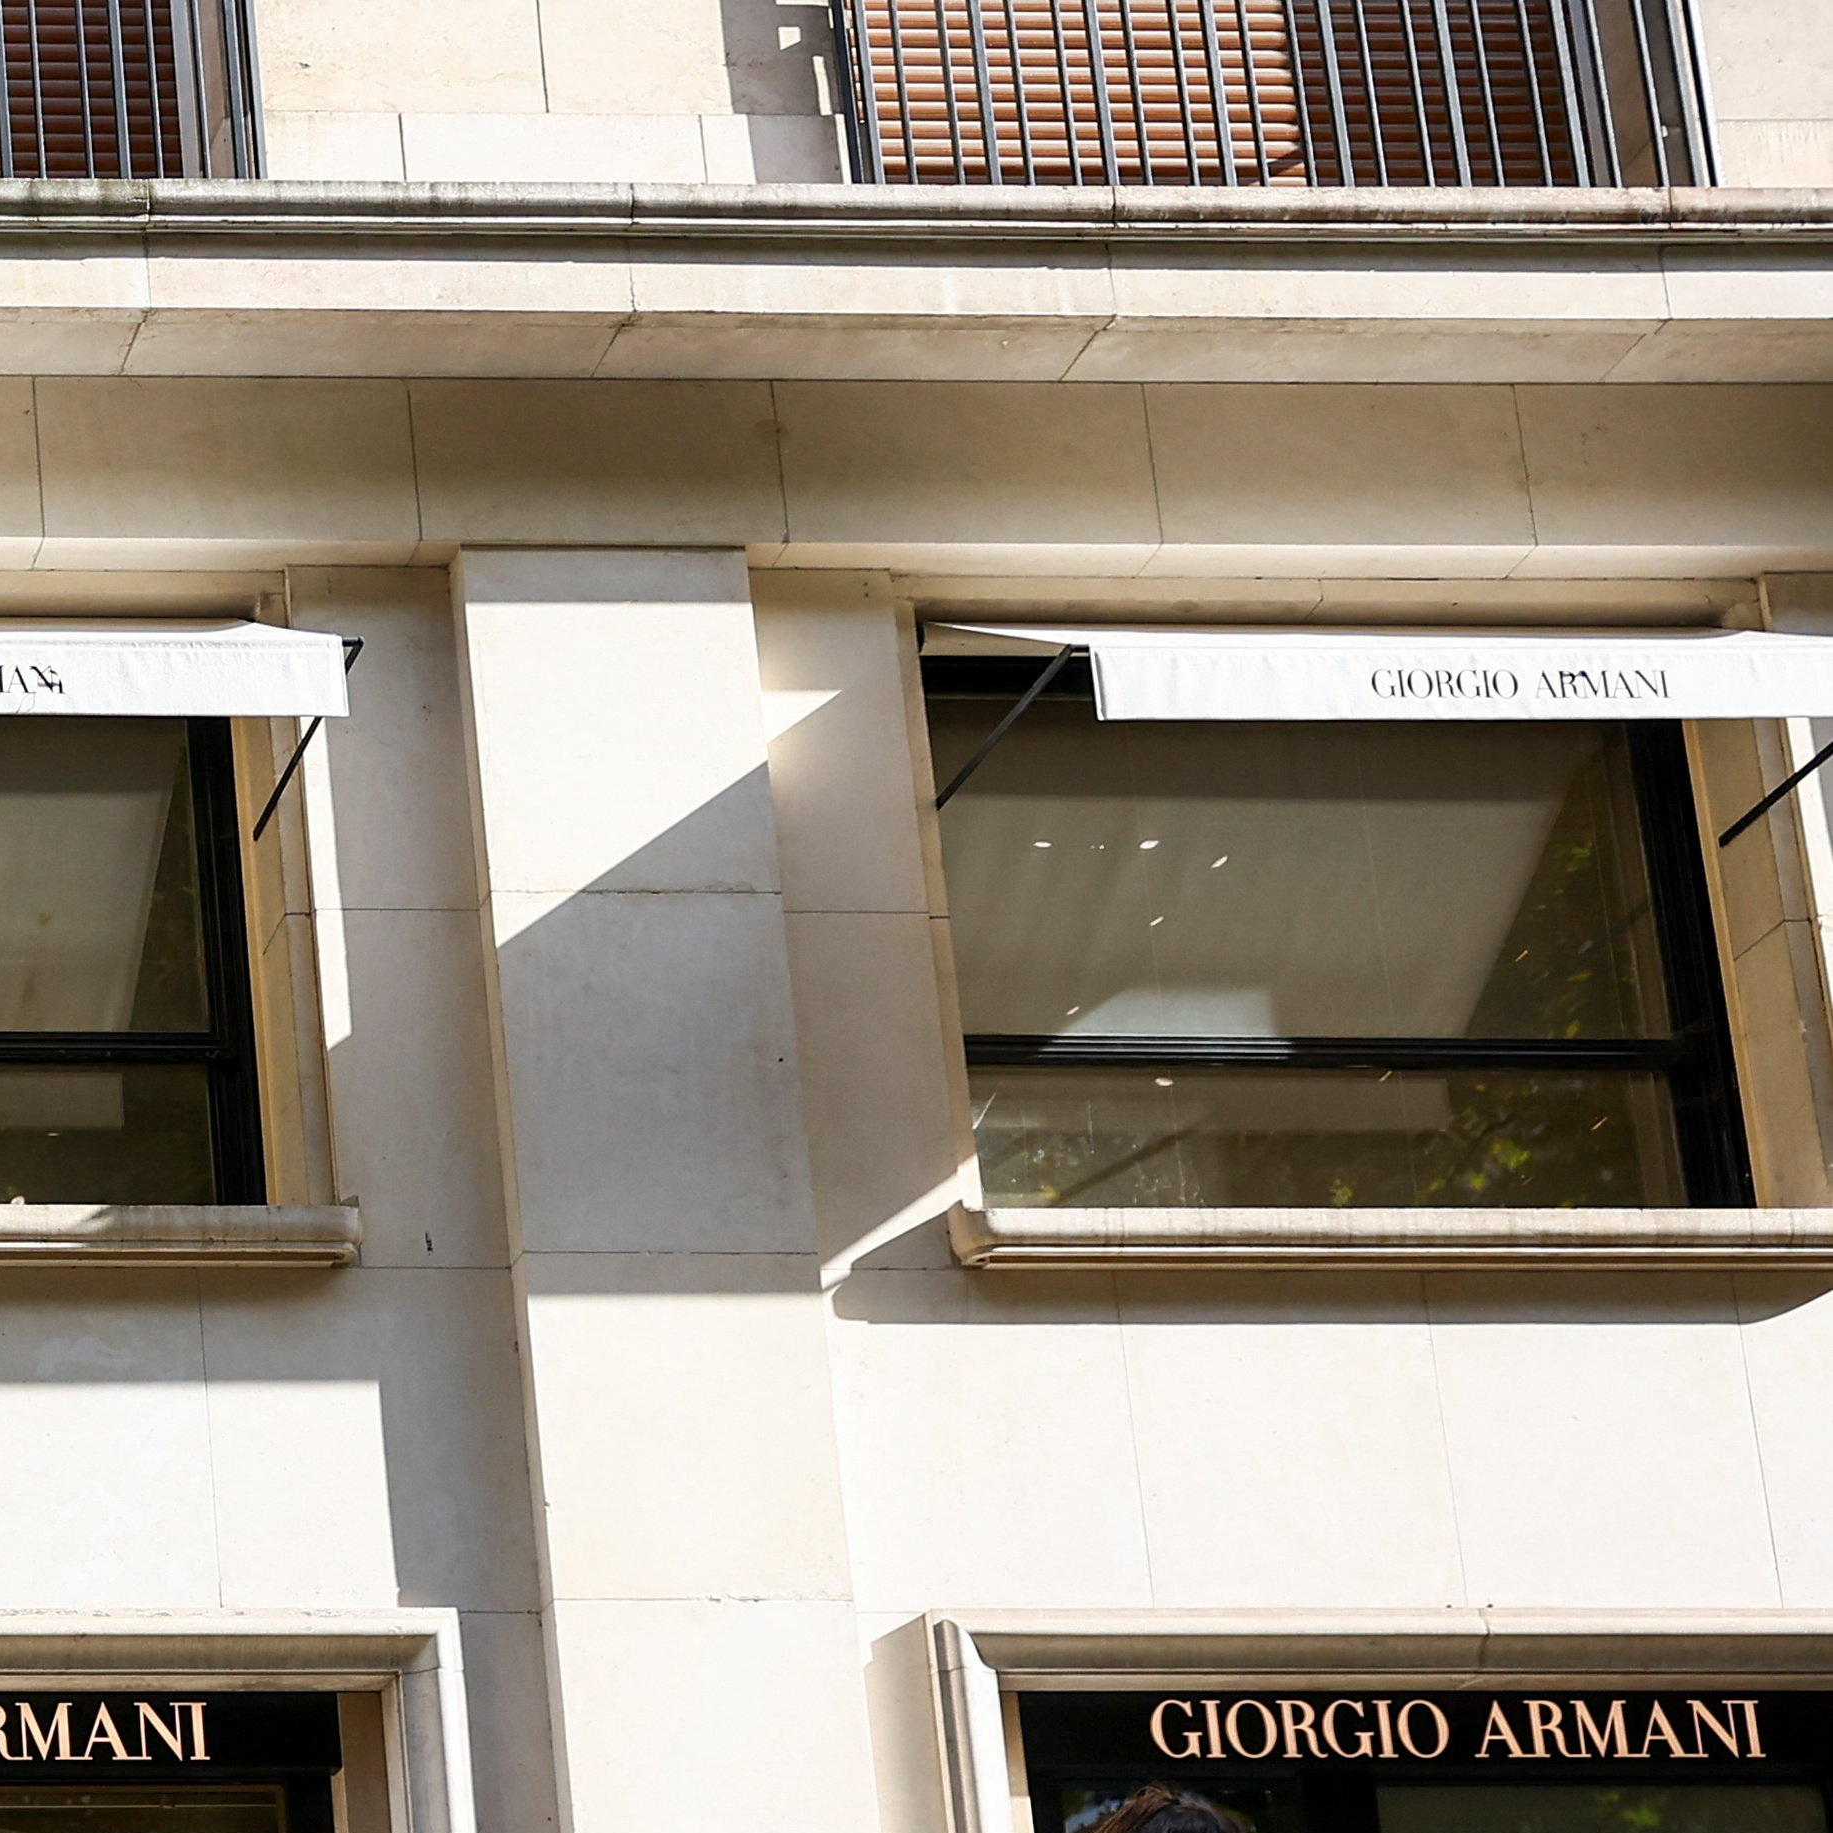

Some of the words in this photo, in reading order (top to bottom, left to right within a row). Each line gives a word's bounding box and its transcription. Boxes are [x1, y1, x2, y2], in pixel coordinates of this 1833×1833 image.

[1370, 669, 1519, 699] GIORGIO
[1535, 669, 1671, 699] ARMANI
[1149, 1699, 1450, 1759] GIORGIO
[1474, 1699, 1767, 1759] ARMANI
